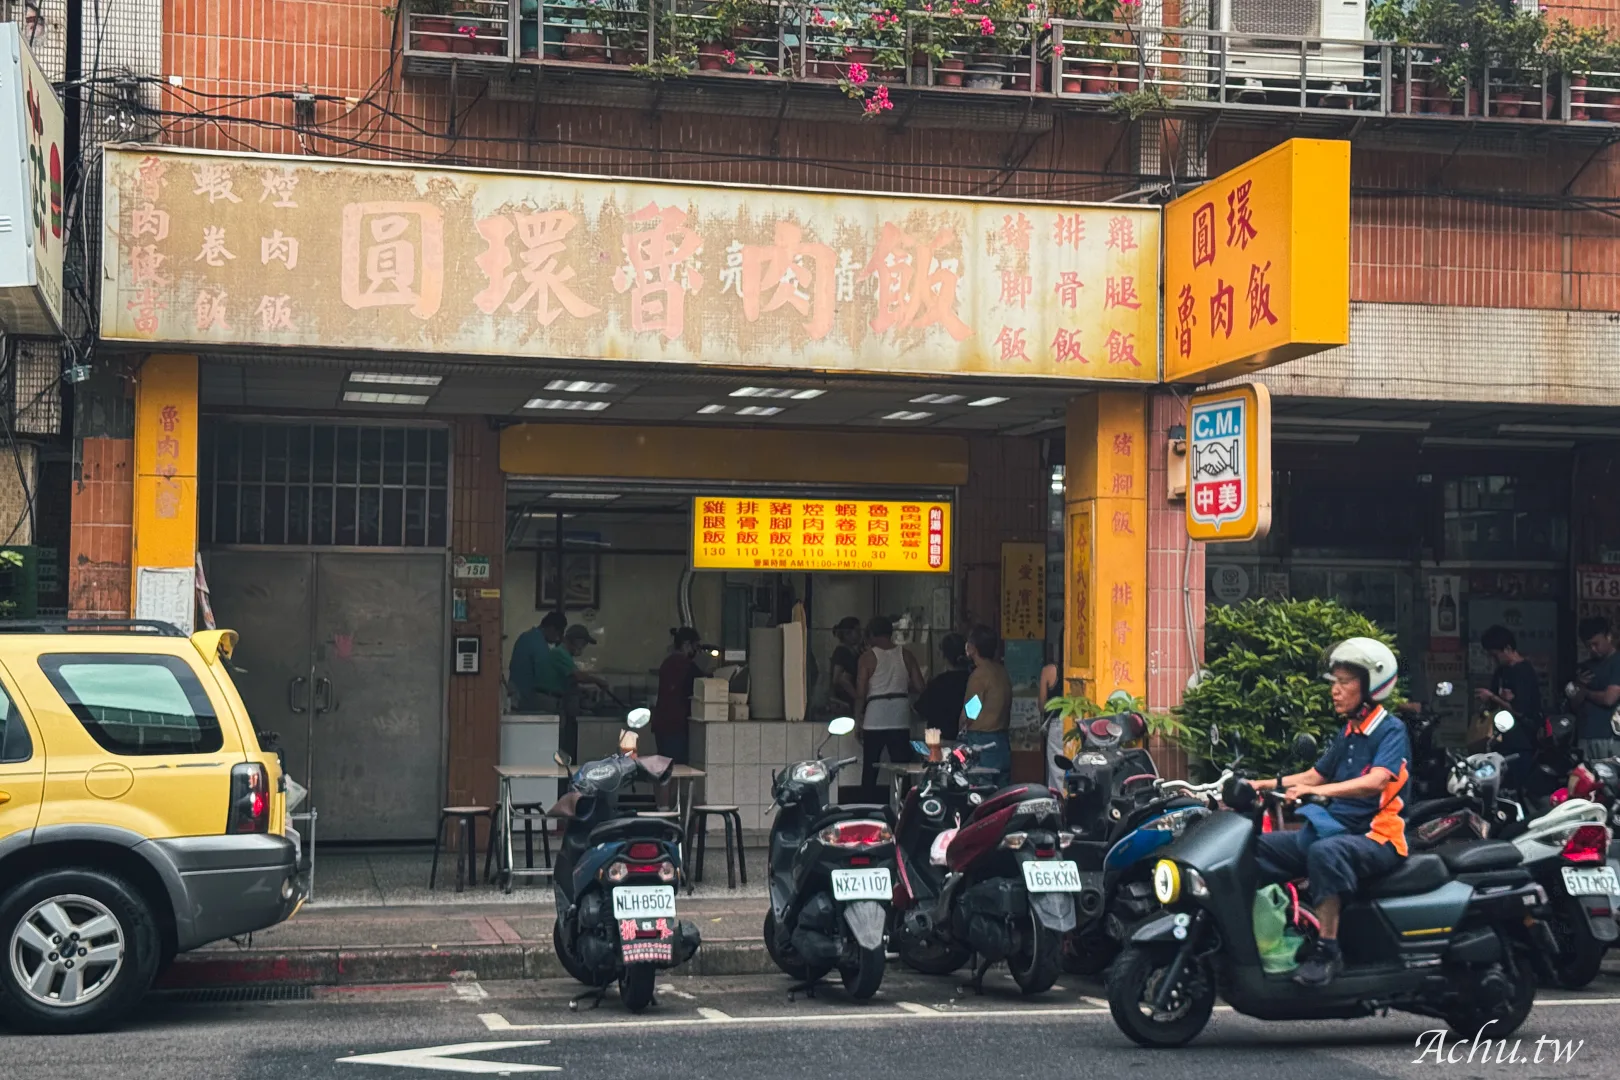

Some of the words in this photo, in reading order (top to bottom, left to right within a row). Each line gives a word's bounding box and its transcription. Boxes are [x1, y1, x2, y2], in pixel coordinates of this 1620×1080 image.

[1192, 180, 1258, 270] 圓環
[341, 200, 975, 342] 圓環魯肉飯
[1050, 212, 1090, 365] 排骨飯
[1104, 215, 1142, 368] 雞腿飯
[1175, 260, 1278, 360] 魯肉飯
[1195, 410, 1239, 438] C.M.
[1197, 483, 1238, 512] 中美
[703, 501, 726, 544] 雞腿飯
[736, 501, 759, 544] 排骨飯
[868, 504, 889, 546] 魯肉飯
[466, 565, 486, 576] 150
[703, 547, 726, 557] 130
[736, 547, 759, 557] 110
[771, 548, 793, 557] 120
[802, 548, 824, 557] 110
[836, 548, 857, 558] 110
[871, 550, 886, 559] 30
[903, 551, 917, 560] 70
[1585, 580, 1619, 597] 148
[1112, 582, 1133, 684] 排骨飯
